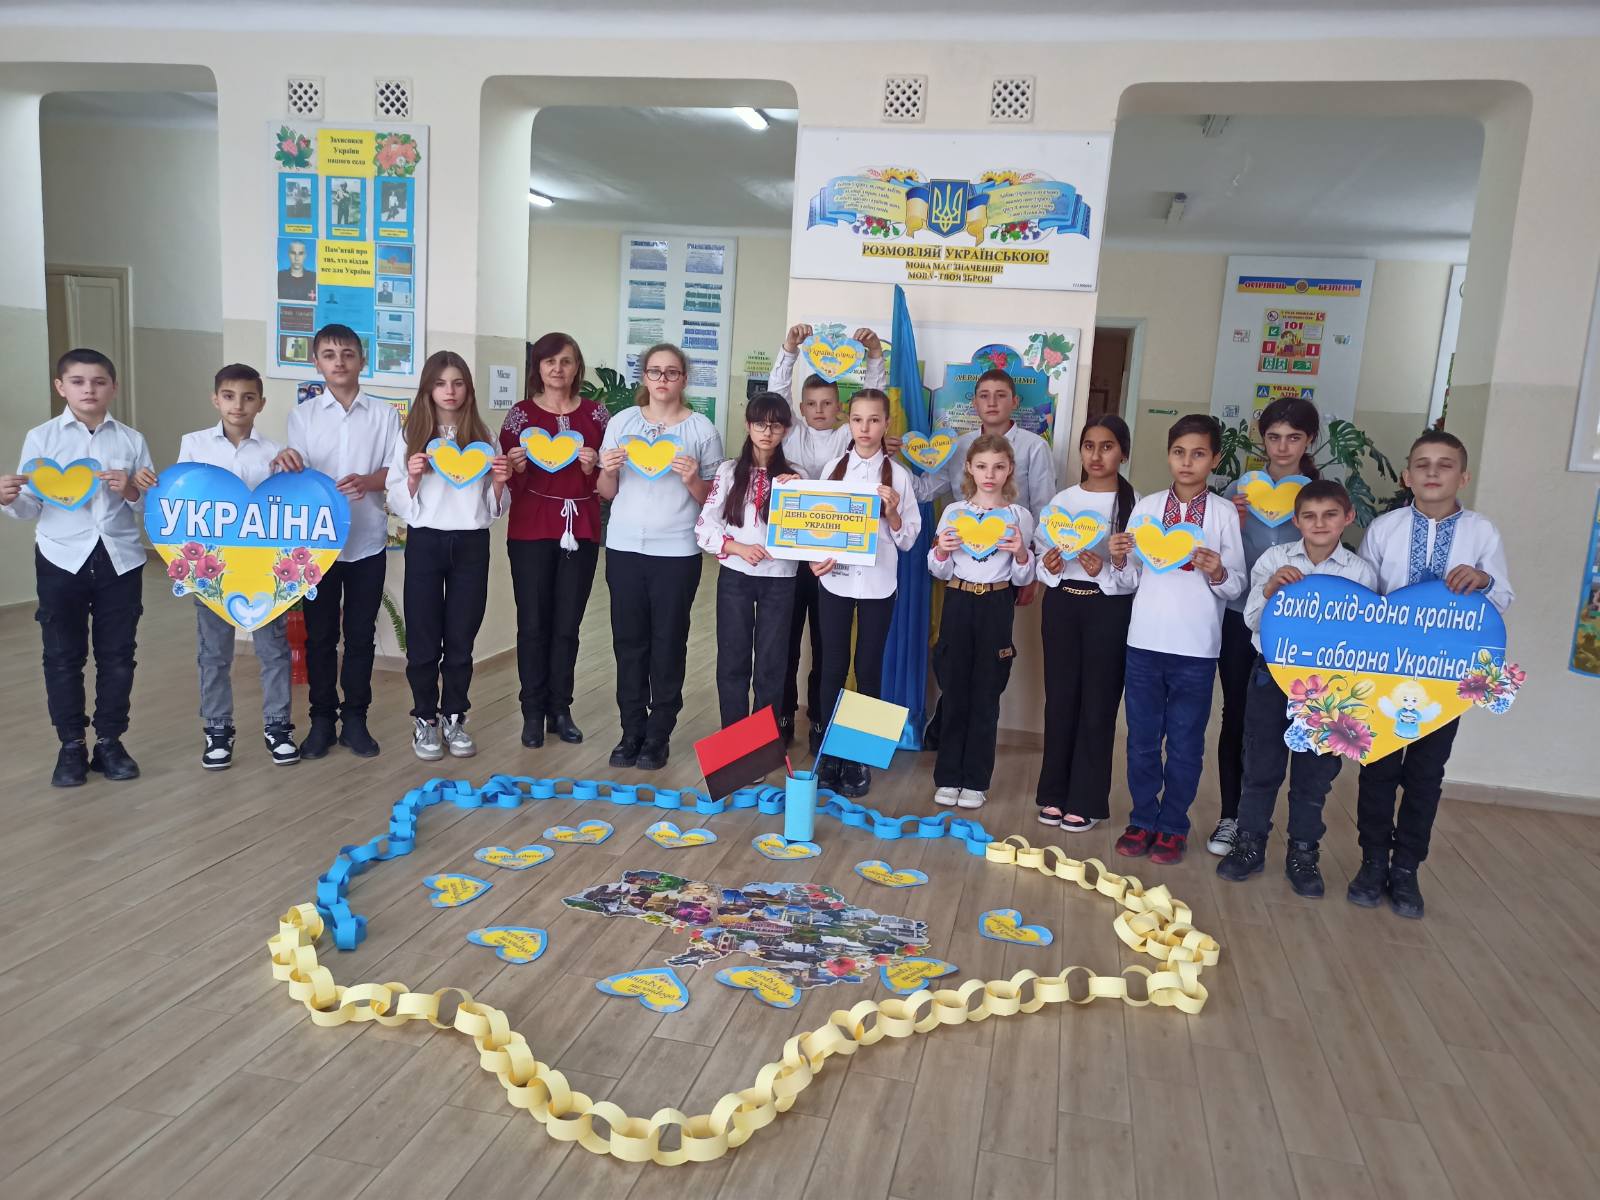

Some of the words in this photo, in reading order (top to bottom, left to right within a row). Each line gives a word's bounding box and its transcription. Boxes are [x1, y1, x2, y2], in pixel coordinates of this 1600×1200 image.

[333, 147, 360, 155] України
[862, 244, 942, 258] РОЗМОВЛЯЙ
[945, 247, 1049, 263] УКРАЇНСЬКОЮ!
[345, 267, 371, 276] України
[905, 261, 931, 270] МОВА
[953, 263, 1004, 273] ЗНАЧЕННЯ!
[907, 271, 933, 280] МОВА
[939, 272, 961, 281] ТВОЯ
[962, 274, 992, 283] ЗБРОЯ!
[1284, 321, 1304, 330] 101
[159, 495, 338, 542] УКРАЇНА
[784, 510, 807, 518] ДЕНЬ
[809, 512, 864, 522] СОБОРНОСТІ
[805, 521, 841, 530] УКРАЇНИ
[1414, 601, 1486, 634] країна!
[1274, 637, 1298, 669] Це
[1316, 640, 1390, 676] соборна
[1394, 646, 1476, 681] Україна!
